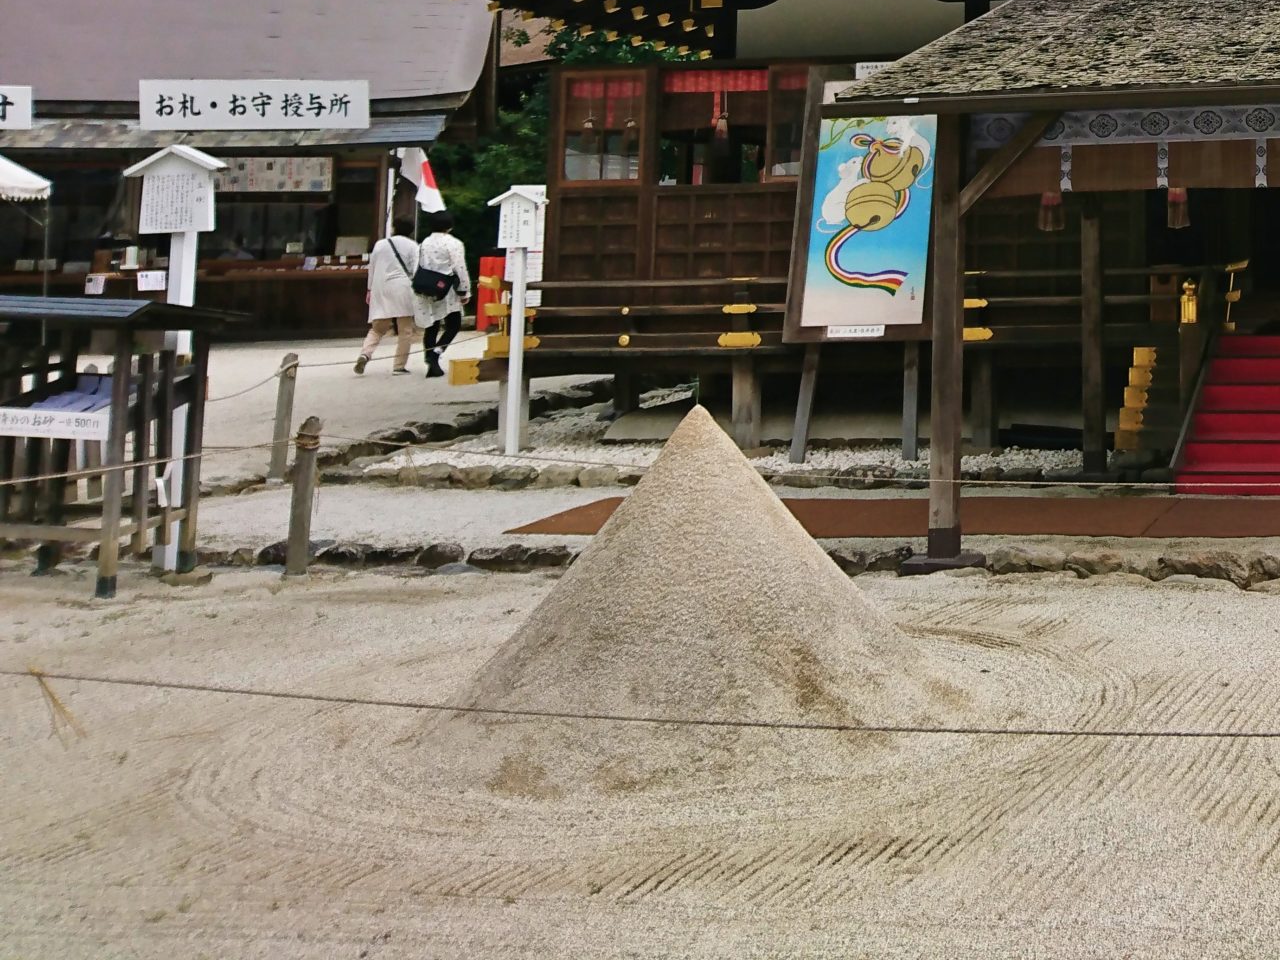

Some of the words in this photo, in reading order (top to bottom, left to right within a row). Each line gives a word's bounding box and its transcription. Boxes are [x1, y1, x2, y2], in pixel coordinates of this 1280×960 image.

[155, 92, 273, 118] お札・お守
[280, 93, 351, 118] 授与所
